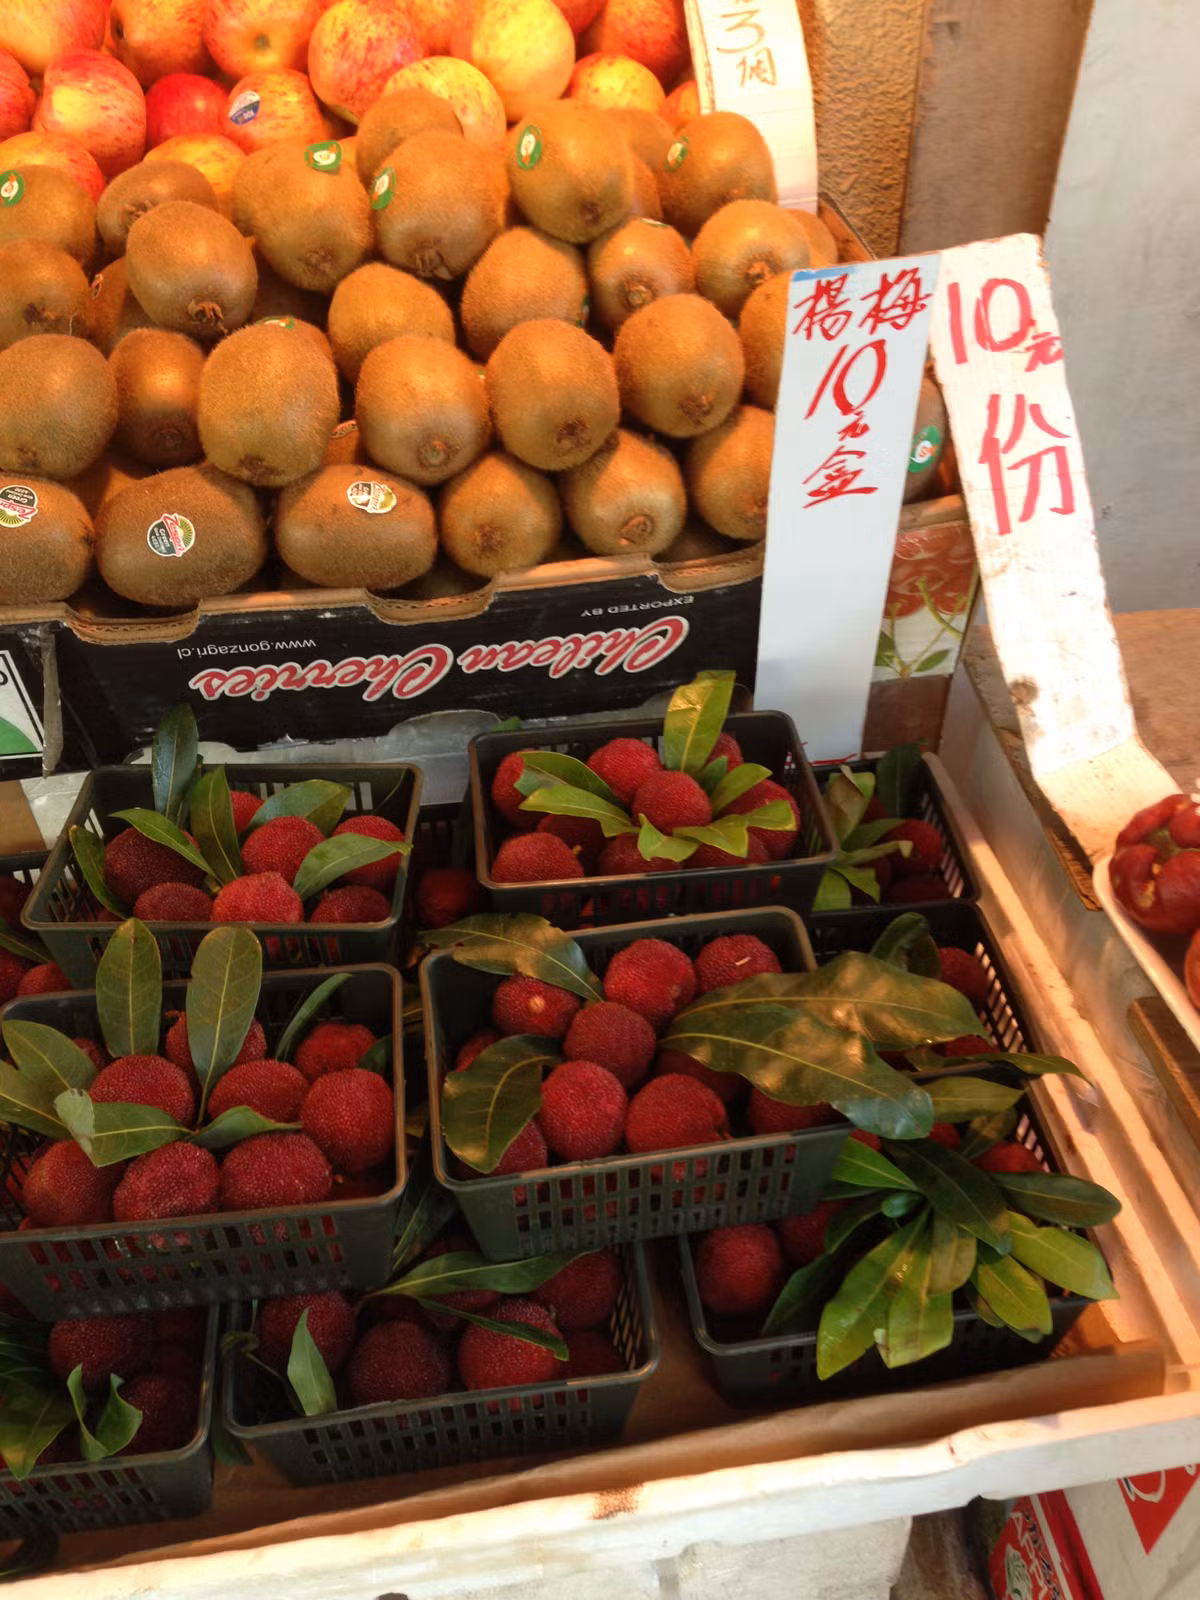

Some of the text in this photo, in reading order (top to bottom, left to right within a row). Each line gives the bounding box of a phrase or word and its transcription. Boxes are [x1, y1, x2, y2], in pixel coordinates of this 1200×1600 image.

[792, 266, 933, 341] 楊梅
[978, 394, 1075, 536] 份
[580, 595, 694, 617] EXPORTED BY
[177, 639, 316, 659] www.gonzagri.cl
[188, 616, 690, 701] Chilean Cherries
